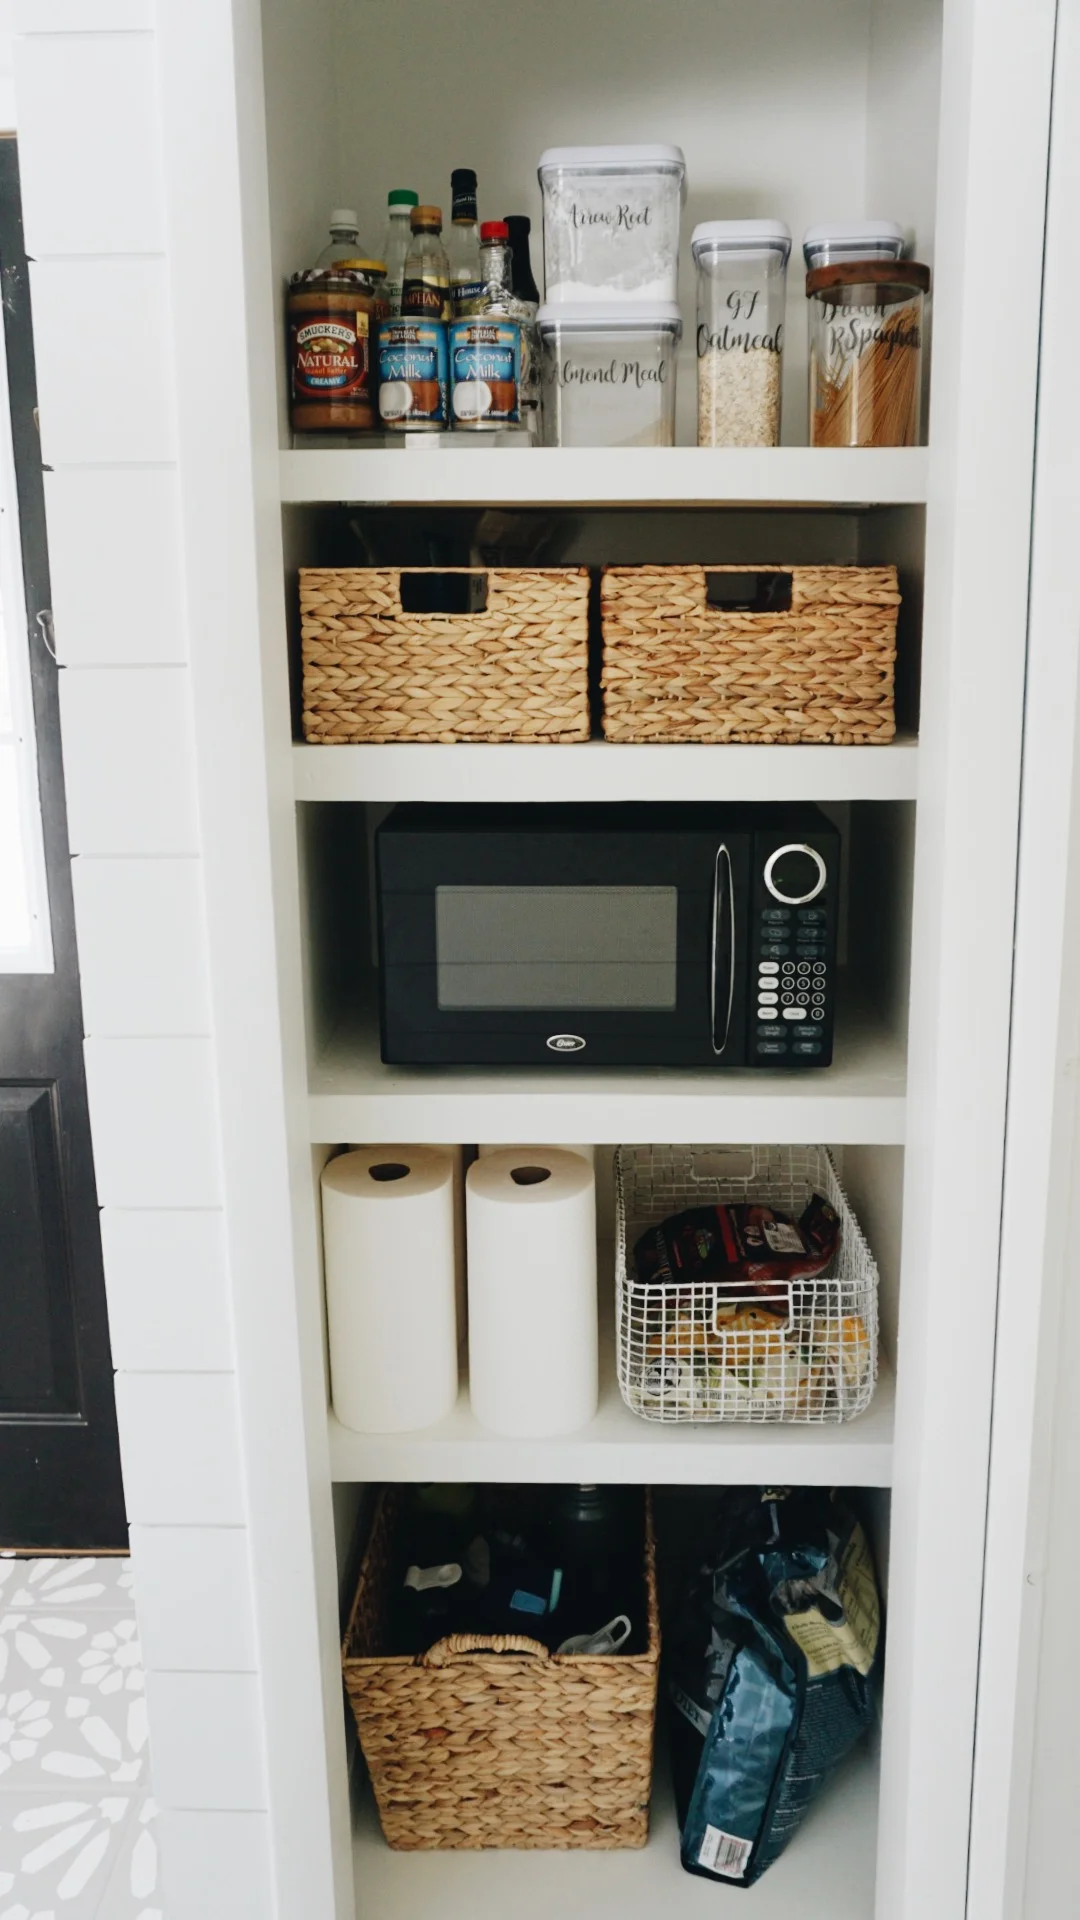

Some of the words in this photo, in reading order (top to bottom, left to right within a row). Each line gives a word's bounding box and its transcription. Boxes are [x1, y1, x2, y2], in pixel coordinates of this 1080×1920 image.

[569, 203, 613, 228] Arrow
[616, 204, 651, 230] Root
[299, 325, 352, 340] SMUCKER'S
[696, 322, 782, 358] Oatmeal
[379, 349, 435, 363] Coconut
[454, 348, 513, 363] Coconut
[388, 363, 422, 380] Milk
[465, 363, 500, 380] Milk
[620, 359, 668, 388] Meal
